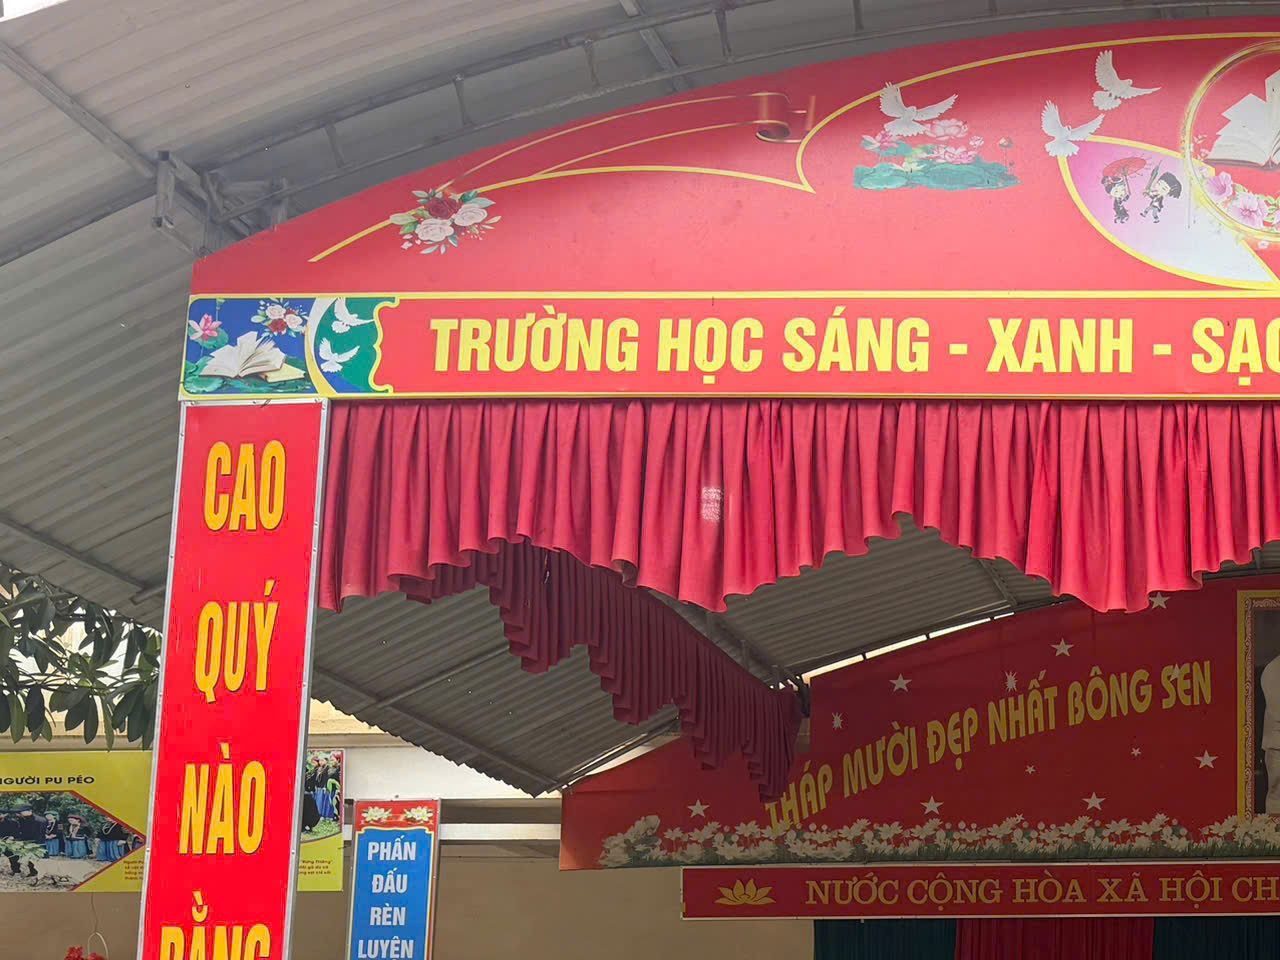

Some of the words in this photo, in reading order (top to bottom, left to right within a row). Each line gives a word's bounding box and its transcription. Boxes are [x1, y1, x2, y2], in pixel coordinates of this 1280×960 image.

[430, 305, 638, 372] TRƯỜNG
[659, 317, 763, 385] HỌC
[783, 307, 930, 373] SÁNG
[986, 317, 1133, 374] XANH
[204, 440, 286, 531] CAO
[195, 579, 278, 703] QUÝ
[842, 720, 919, 799] MƯỜI
[927, 705, 978, 771] ĐẸP
[987, 669, 1057, 744] NHẤT
[1067, 666, 1153, 727] BÔNG
[1160, 659, 1212, 710] SEN
[66, 774, 95, 784] PÉO
[179, 743, 266, 854] NÀO
[368, 835, 416, 861] PHẤN
[372, 868, 408, 893] ĐẤU
[805, 874, 899, 905] NƯỚC
[907, 872, 1003, 911] CỘNG
[1011, 870, 1085, 904] HÒA
[1097, 872, 1149, 903] XÃ
[1158, 872, 1221, 909] HỘI
[370, 903, 406, 926] RÈN
